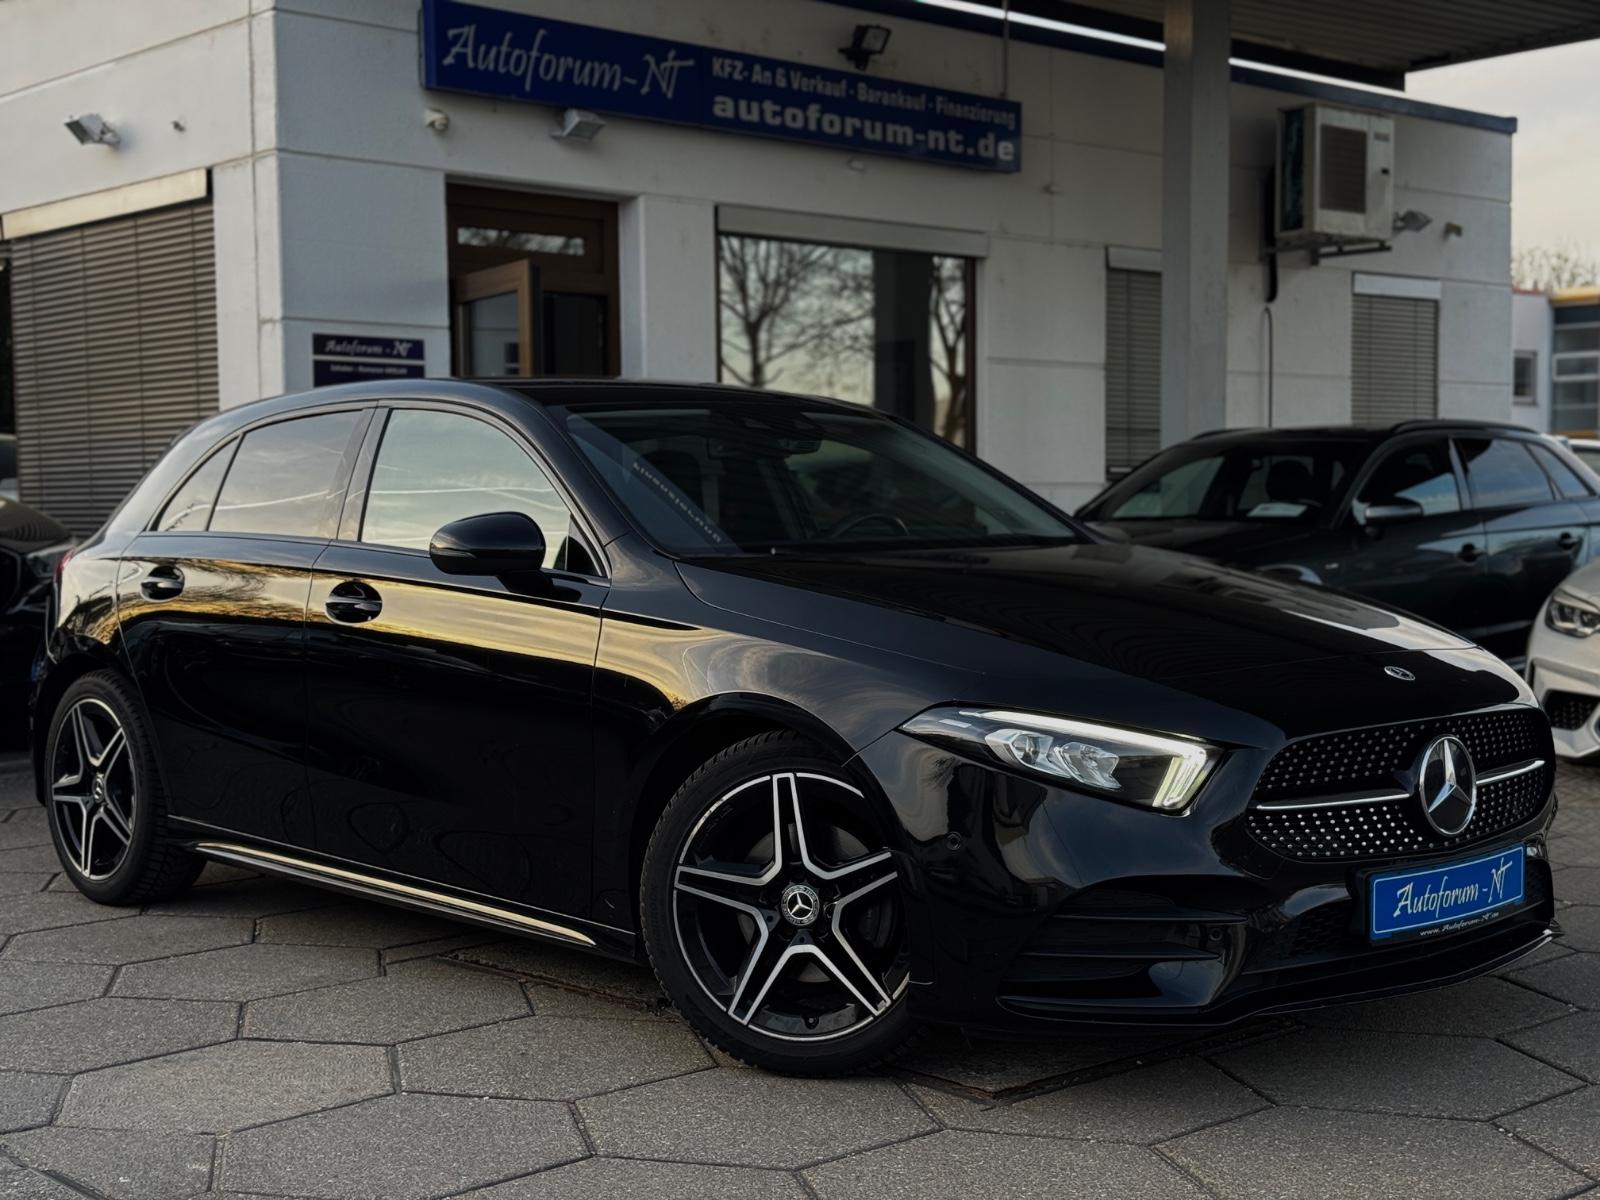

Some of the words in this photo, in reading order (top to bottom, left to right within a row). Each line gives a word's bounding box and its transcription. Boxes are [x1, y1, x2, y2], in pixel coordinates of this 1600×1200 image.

[442, 24, 694, 99] Autoforum-NT
[712, 94, 1015, 161] autoforum-nt.de
[752, 63, 772, 86] An
[775, 68, 787, 88] &
[789, 70, 846, 98] Verkauf
[936, 96, 1015, 129] Finanzierung
